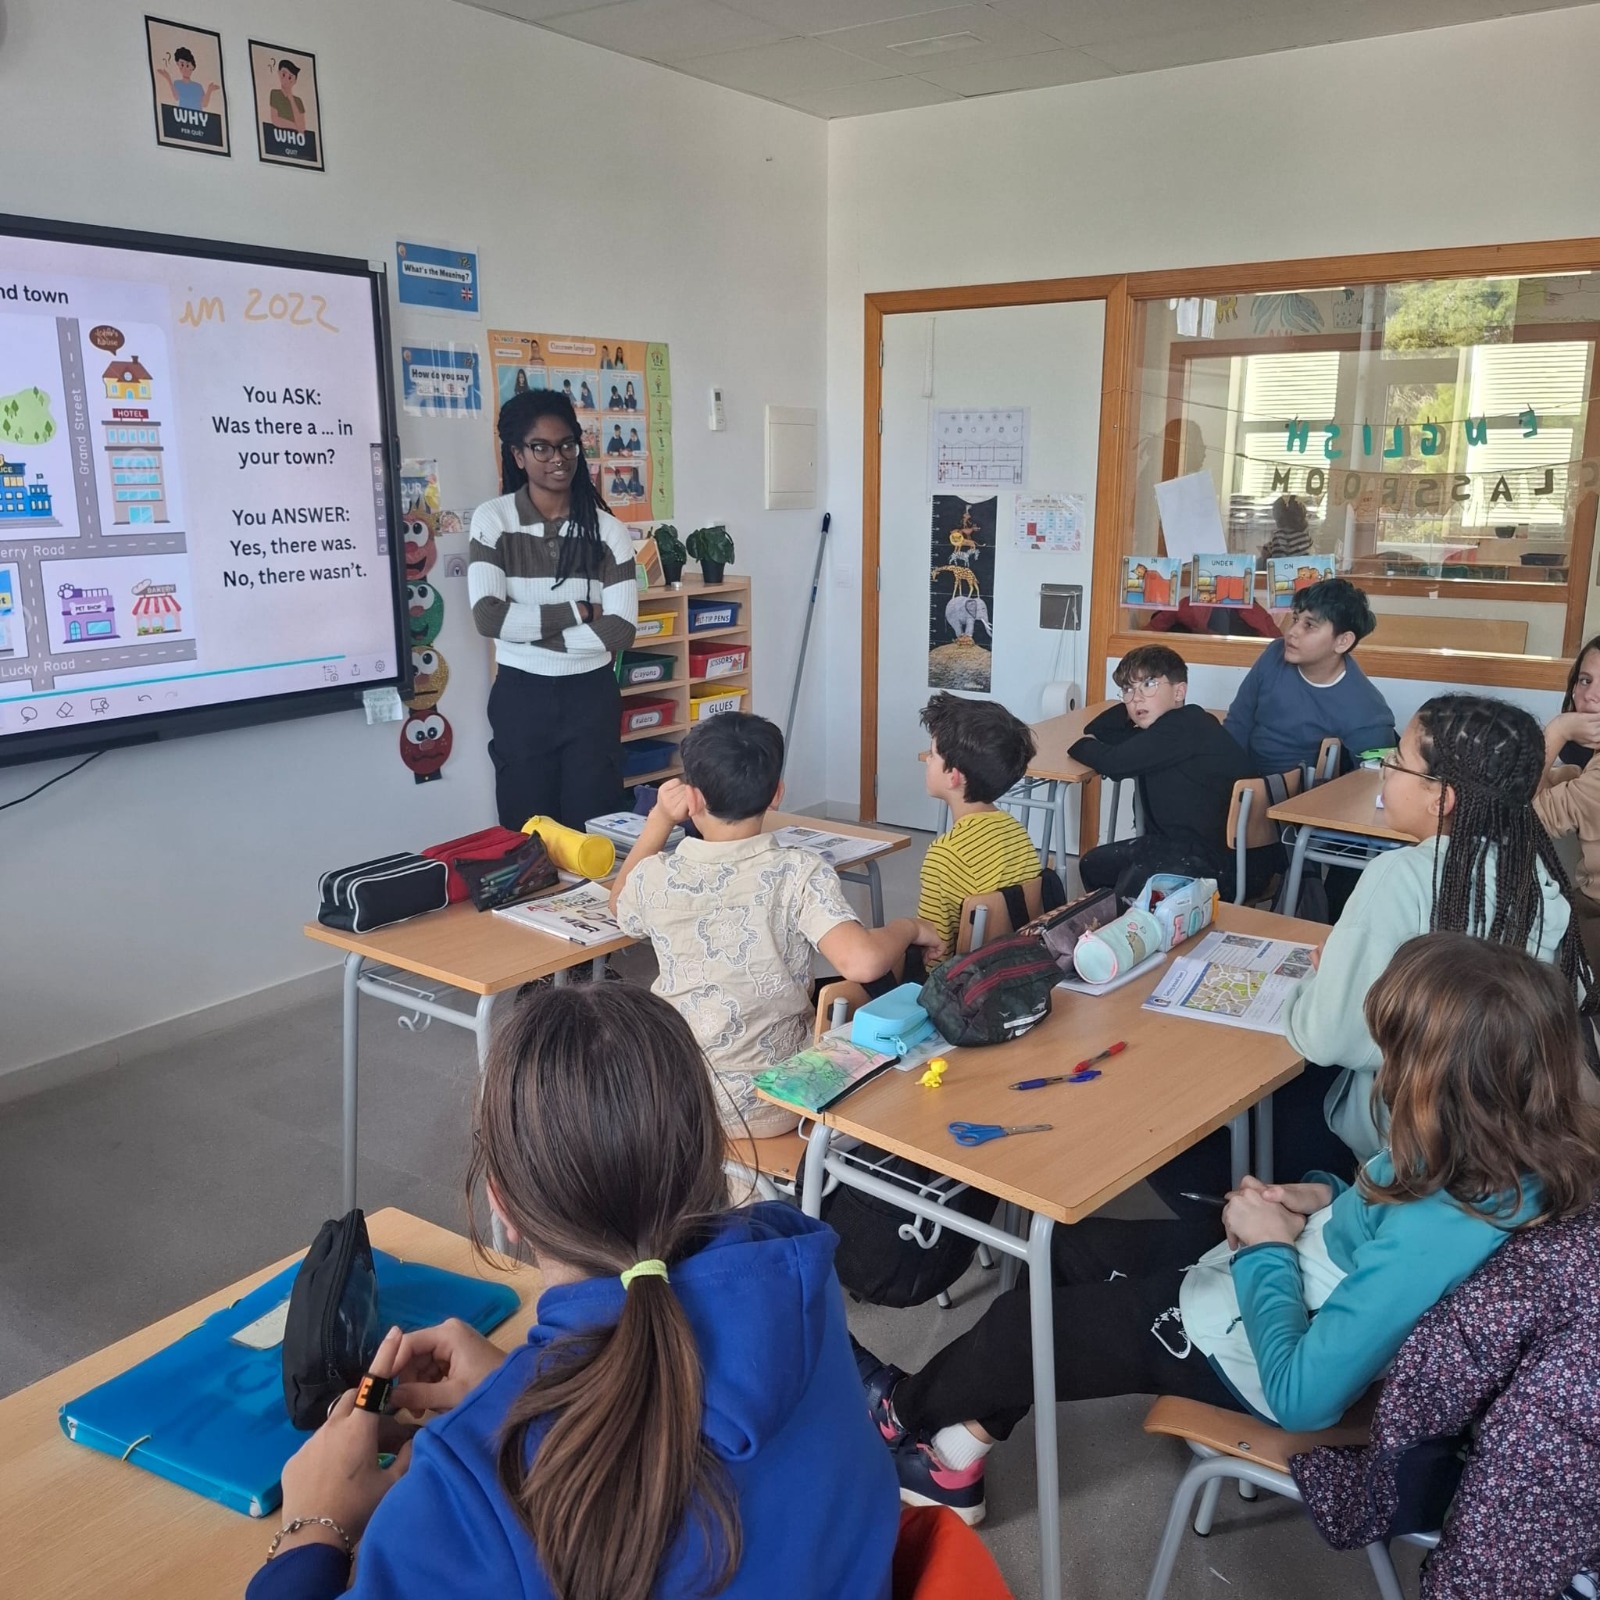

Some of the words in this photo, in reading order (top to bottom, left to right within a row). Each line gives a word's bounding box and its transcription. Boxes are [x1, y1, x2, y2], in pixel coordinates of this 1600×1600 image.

[173, 107, 208, 127] WHY
[273, 128, 306, 146] WHO
[404, 263, 428, 275] What's
[429, 267, 439, 276] the
[439, 268, 470, 282] Meaning?
[23, 285, 69, 304] town
[244, 288, 340, 333] 2022
[411, 368, 430, 378] How
[440, 373, 455, 381] you
[456, 374, 470, 383] say
[243, 386, 277, 404] You
[282, 387, 322, 405] ASK:
[72, 389, 85, 431] Street
[117, 410, 144, 418] HOTEL
[212, 416, 250, 434] Was
[255, 417, 302, 435] there
[307, 422, 317, 435] a
[338, 419, 353, 436] in
[76, 436, 90, 475] Grand
[239, 450, 280, 470] your
[285, 449, 335, 465] town?
[232, 509, 266, 526] You
[271, 506, 350, 525] ANSWER:
[33, 544, 66, 556] Road
[229, 540, 267, 559] Yes,
[270, 537, 317, 554] there
[321, 537, 356, 551] was.
[223, 570, 254, 589] No,
[258, 567, 305, 585] there
[714, 614, 730, 622] PENS
[1, 664, 38, 678] Lucky
[44, 659, 76, 672] Road
[634, 670, 657, 679] Crayons
[709, 701, 733, 713] GLUES
